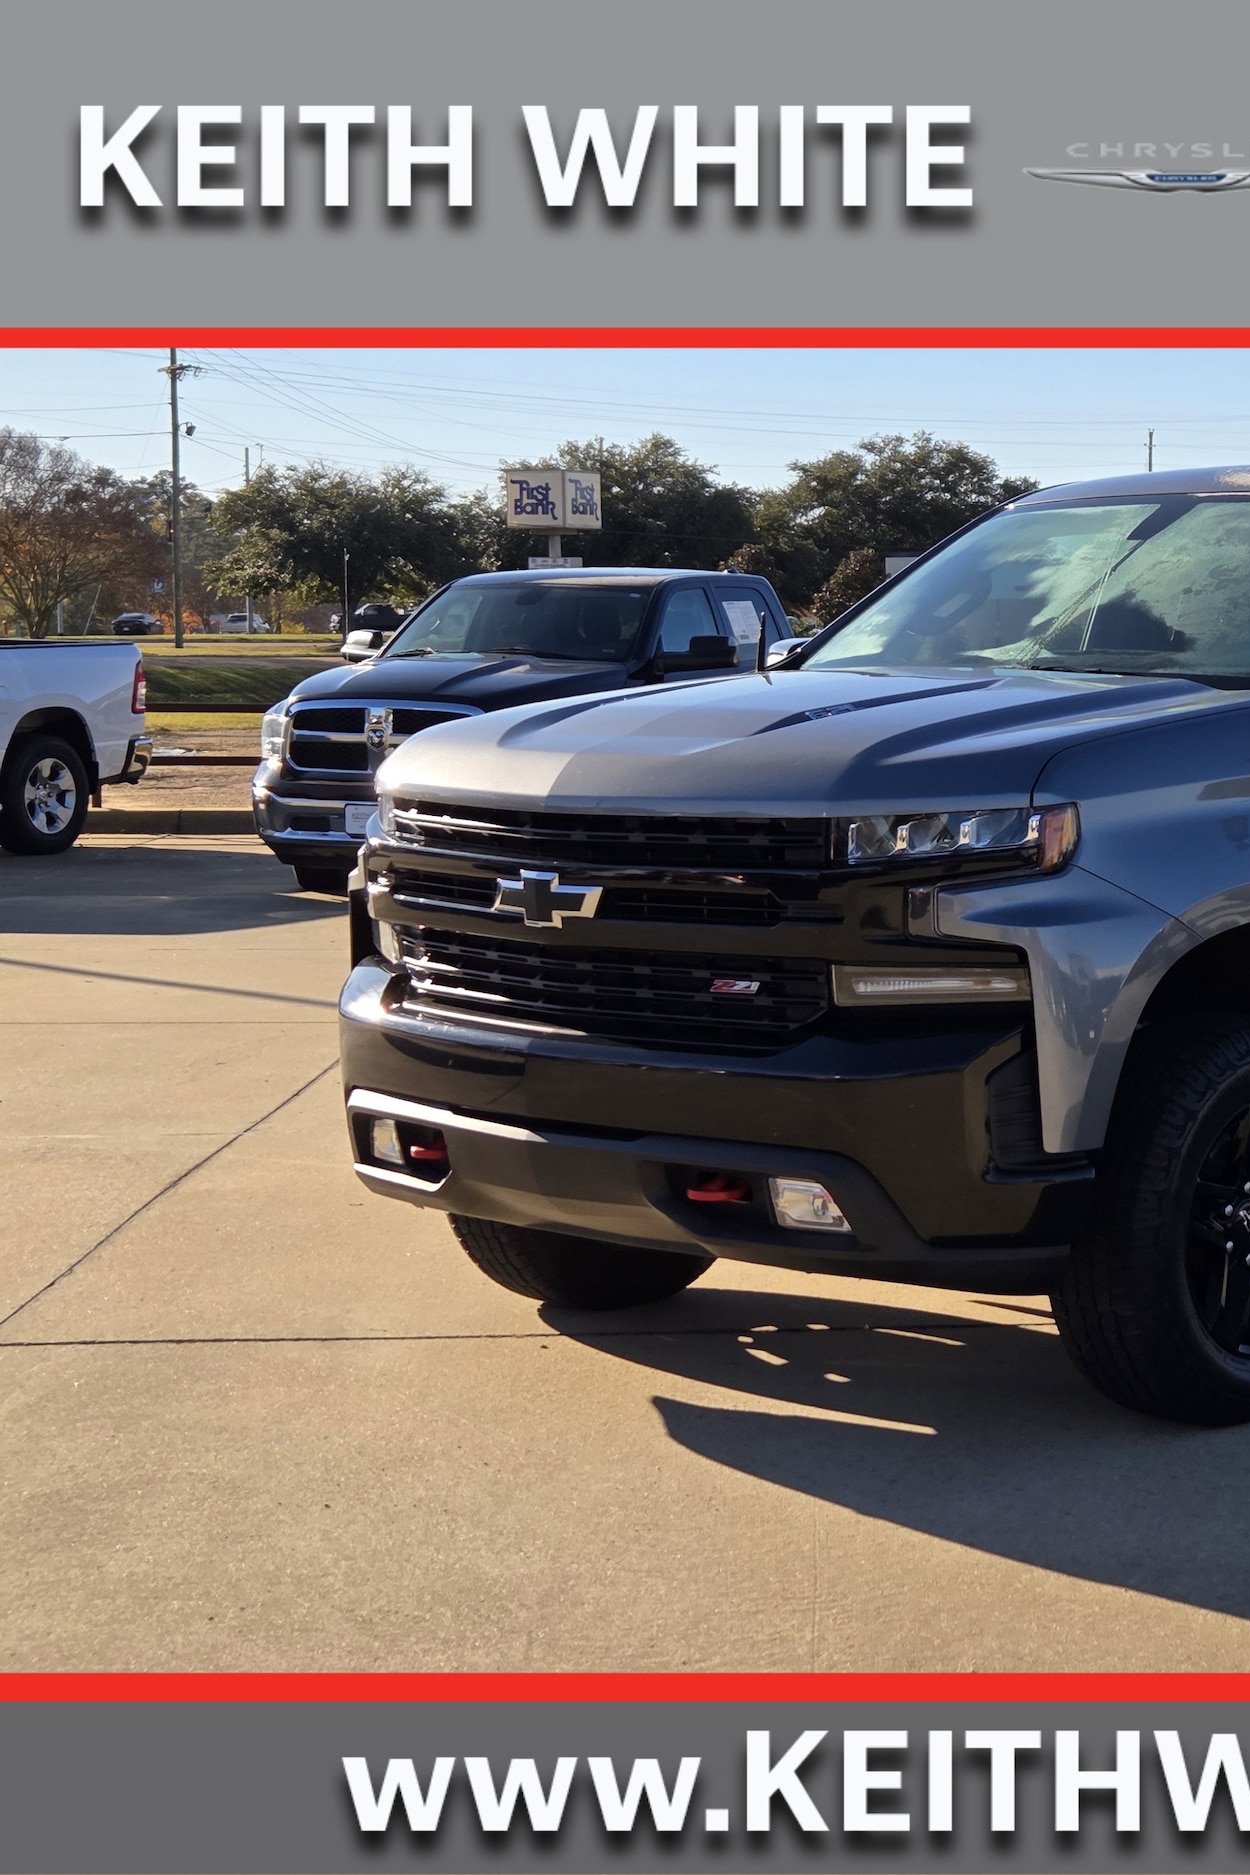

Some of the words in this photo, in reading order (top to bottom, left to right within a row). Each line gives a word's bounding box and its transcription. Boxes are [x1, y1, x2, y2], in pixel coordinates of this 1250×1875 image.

[510, 479, 552, 502] First
[514, 498, 558, 520] Bank
[572, 498, 599, 521] Bank
[709, 979, 760, 994] Z71
